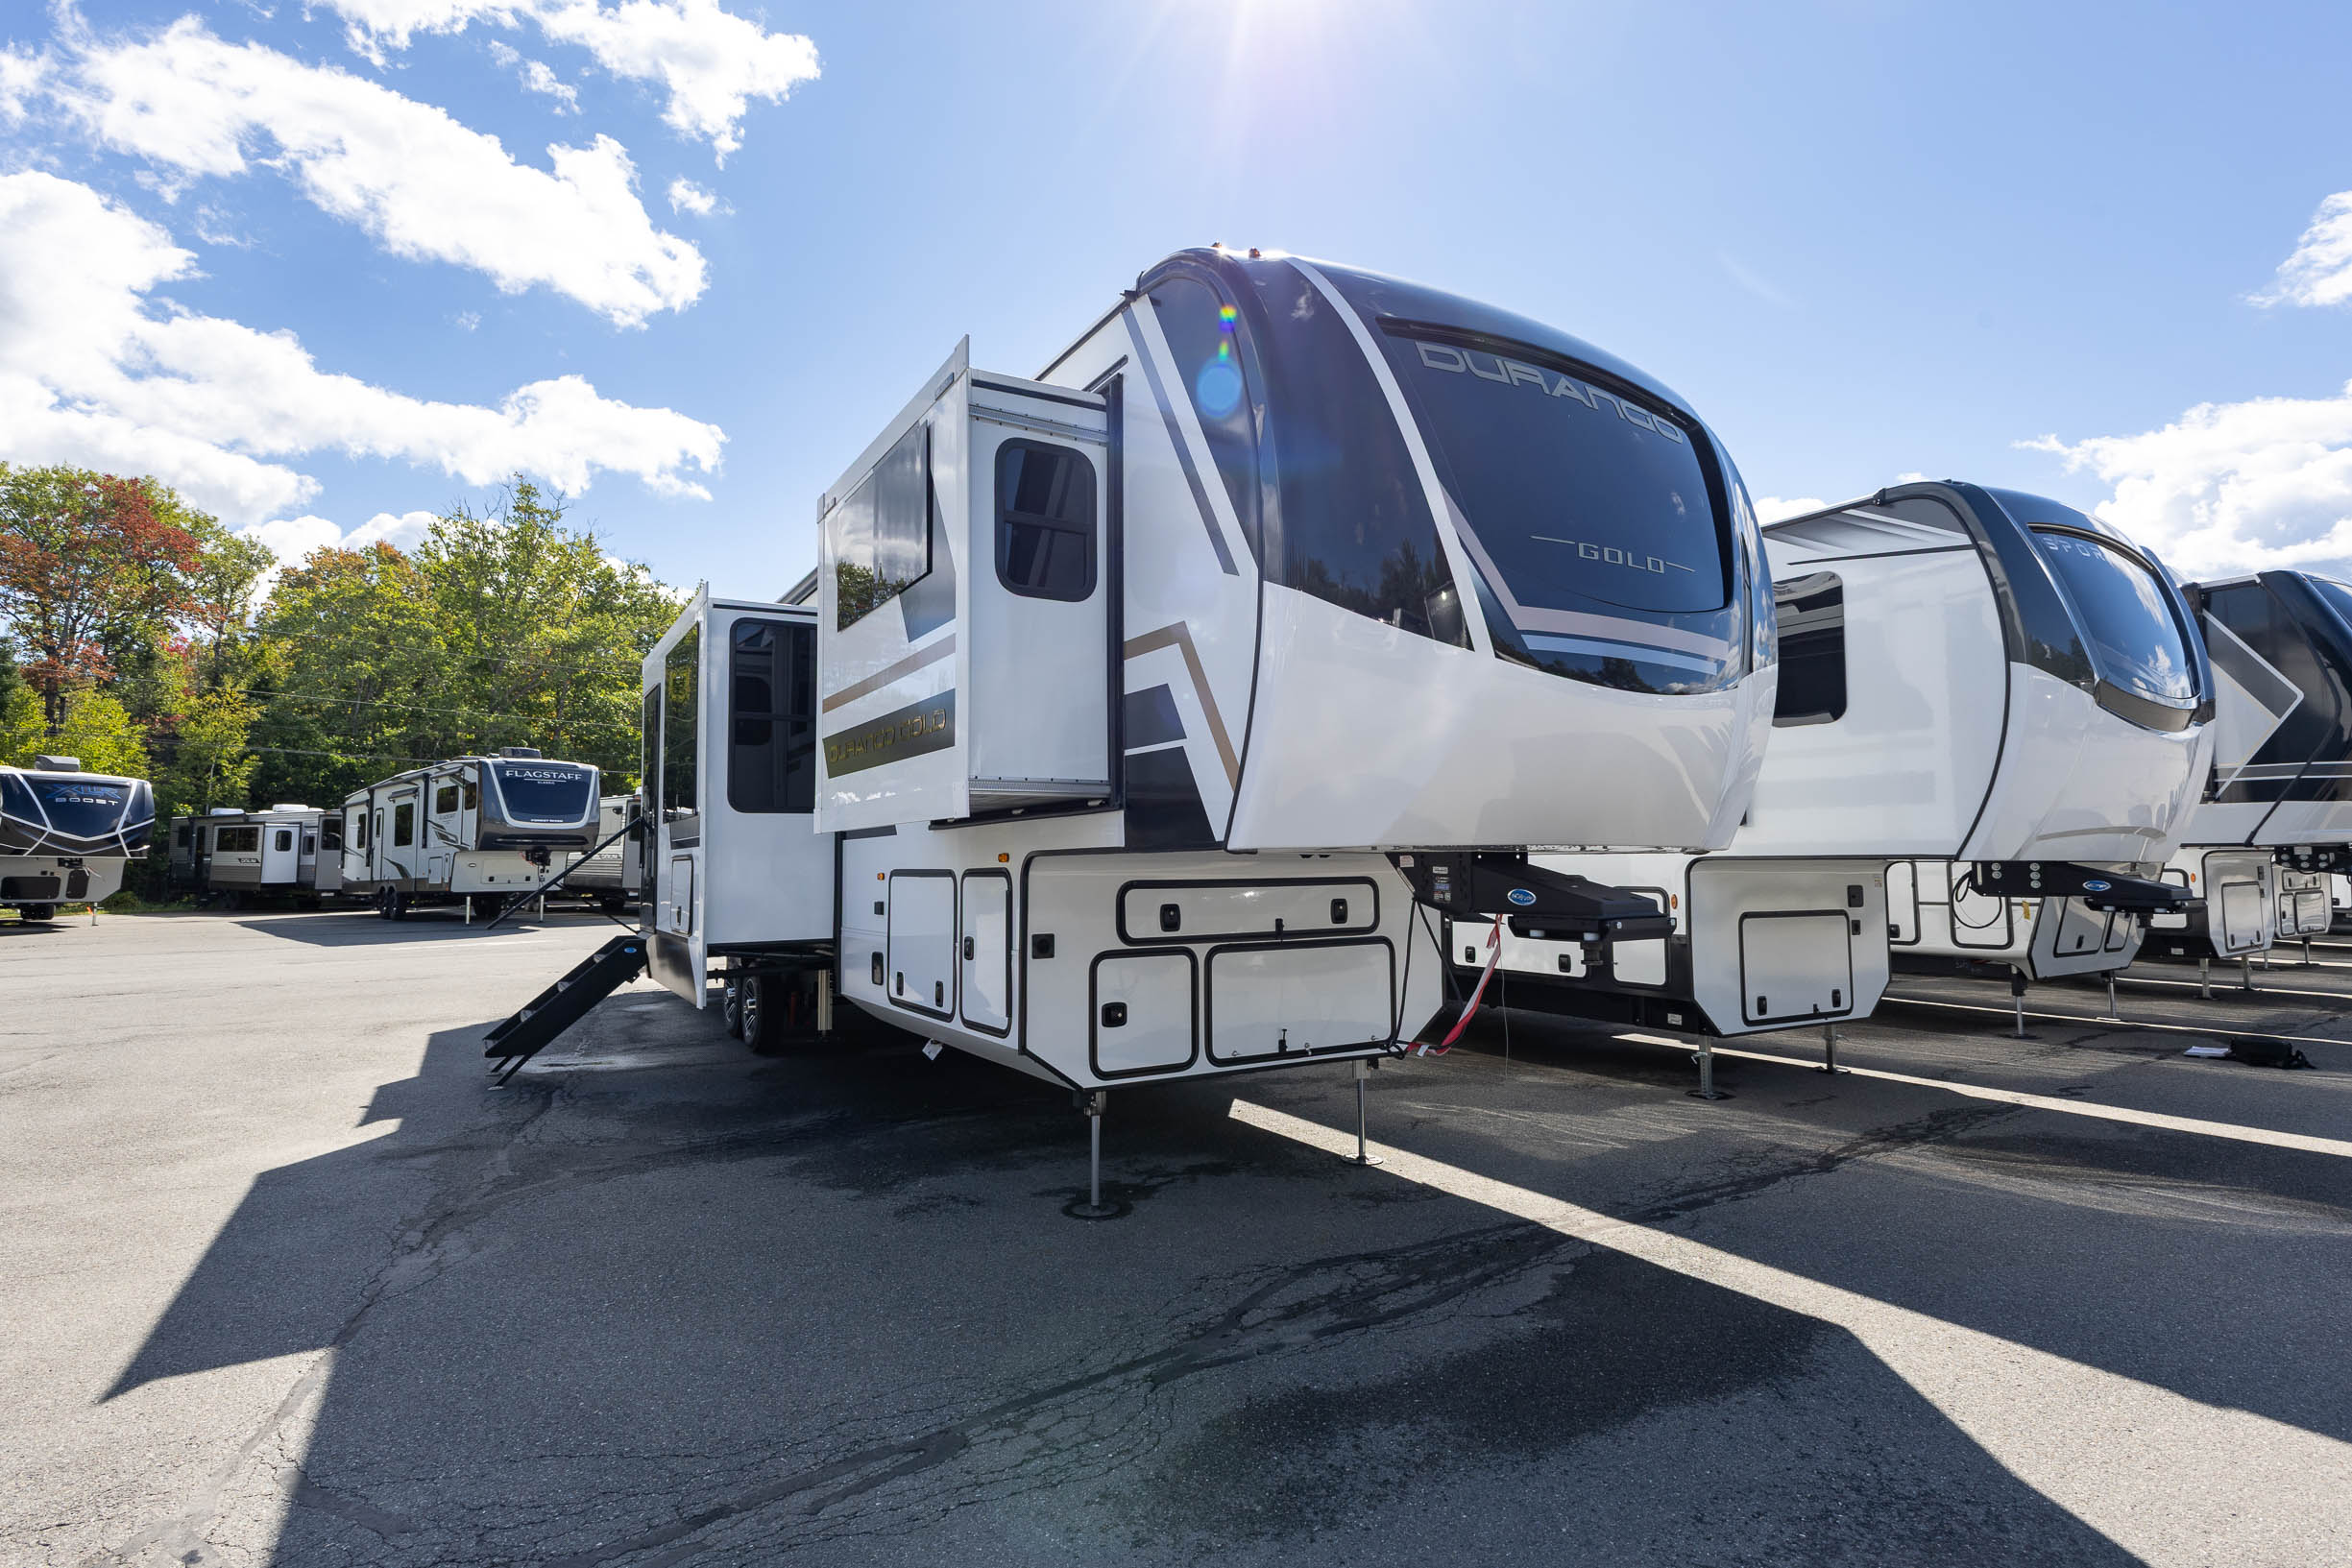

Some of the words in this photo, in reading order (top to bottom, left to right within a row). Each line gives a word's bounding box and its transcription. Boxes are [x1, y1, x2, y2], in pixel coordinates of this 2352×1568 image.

[1415, 340, 1684, 445] DURANGO
[1578, 542, 1665, 574] GOLD
[829, 725, 896, 764] DURANGO
[899, 708, 947, 742] GOLD
[505, 769, 583, 781] FLAGSTAFF
[55, 797, 119, 807] BOOST
